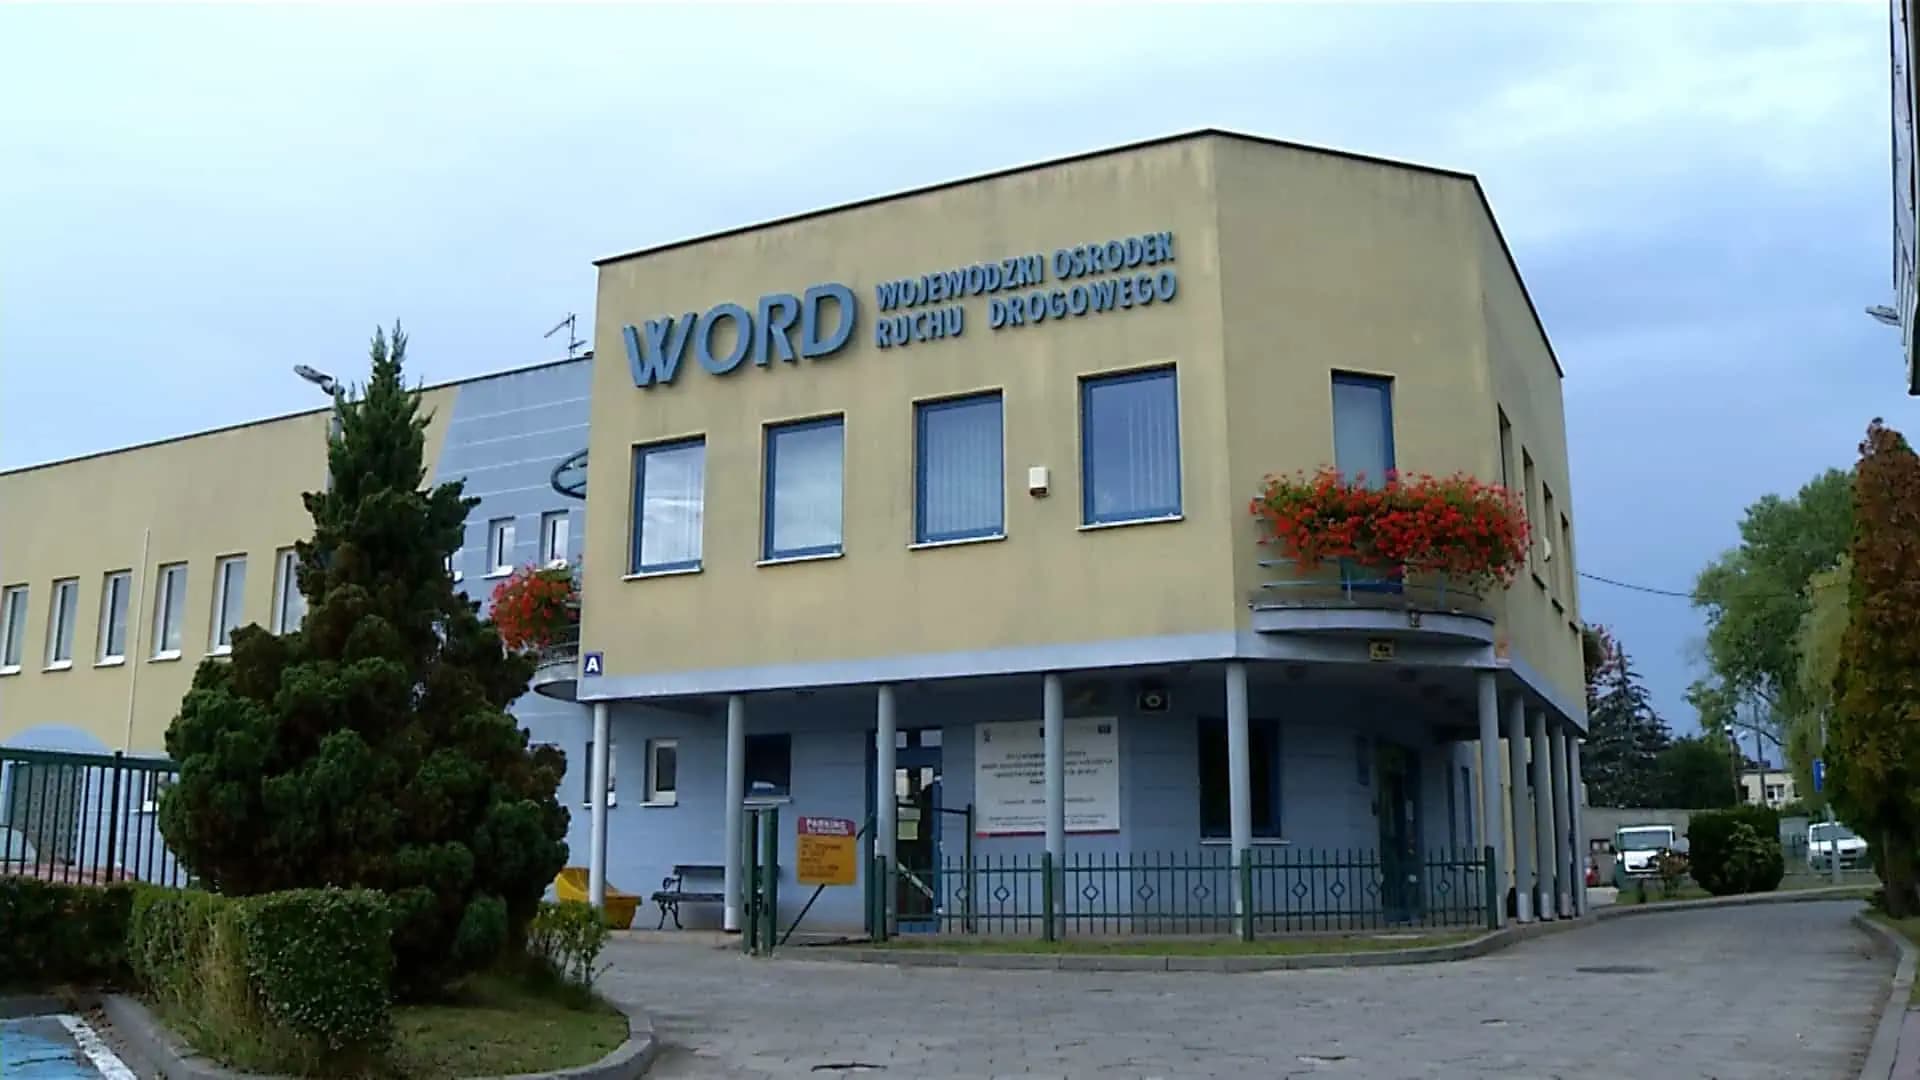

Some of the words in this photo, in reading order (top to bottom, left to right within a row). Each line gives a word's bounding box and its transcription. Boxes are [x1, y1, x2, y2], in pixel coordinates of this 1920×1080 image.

[623, 283, 856, 388] WORD
[876, 304, 964, 347] RUCHU
[988, 269, 1176, 329] DROGOWEGO
[586, 656, 599, 672] A
